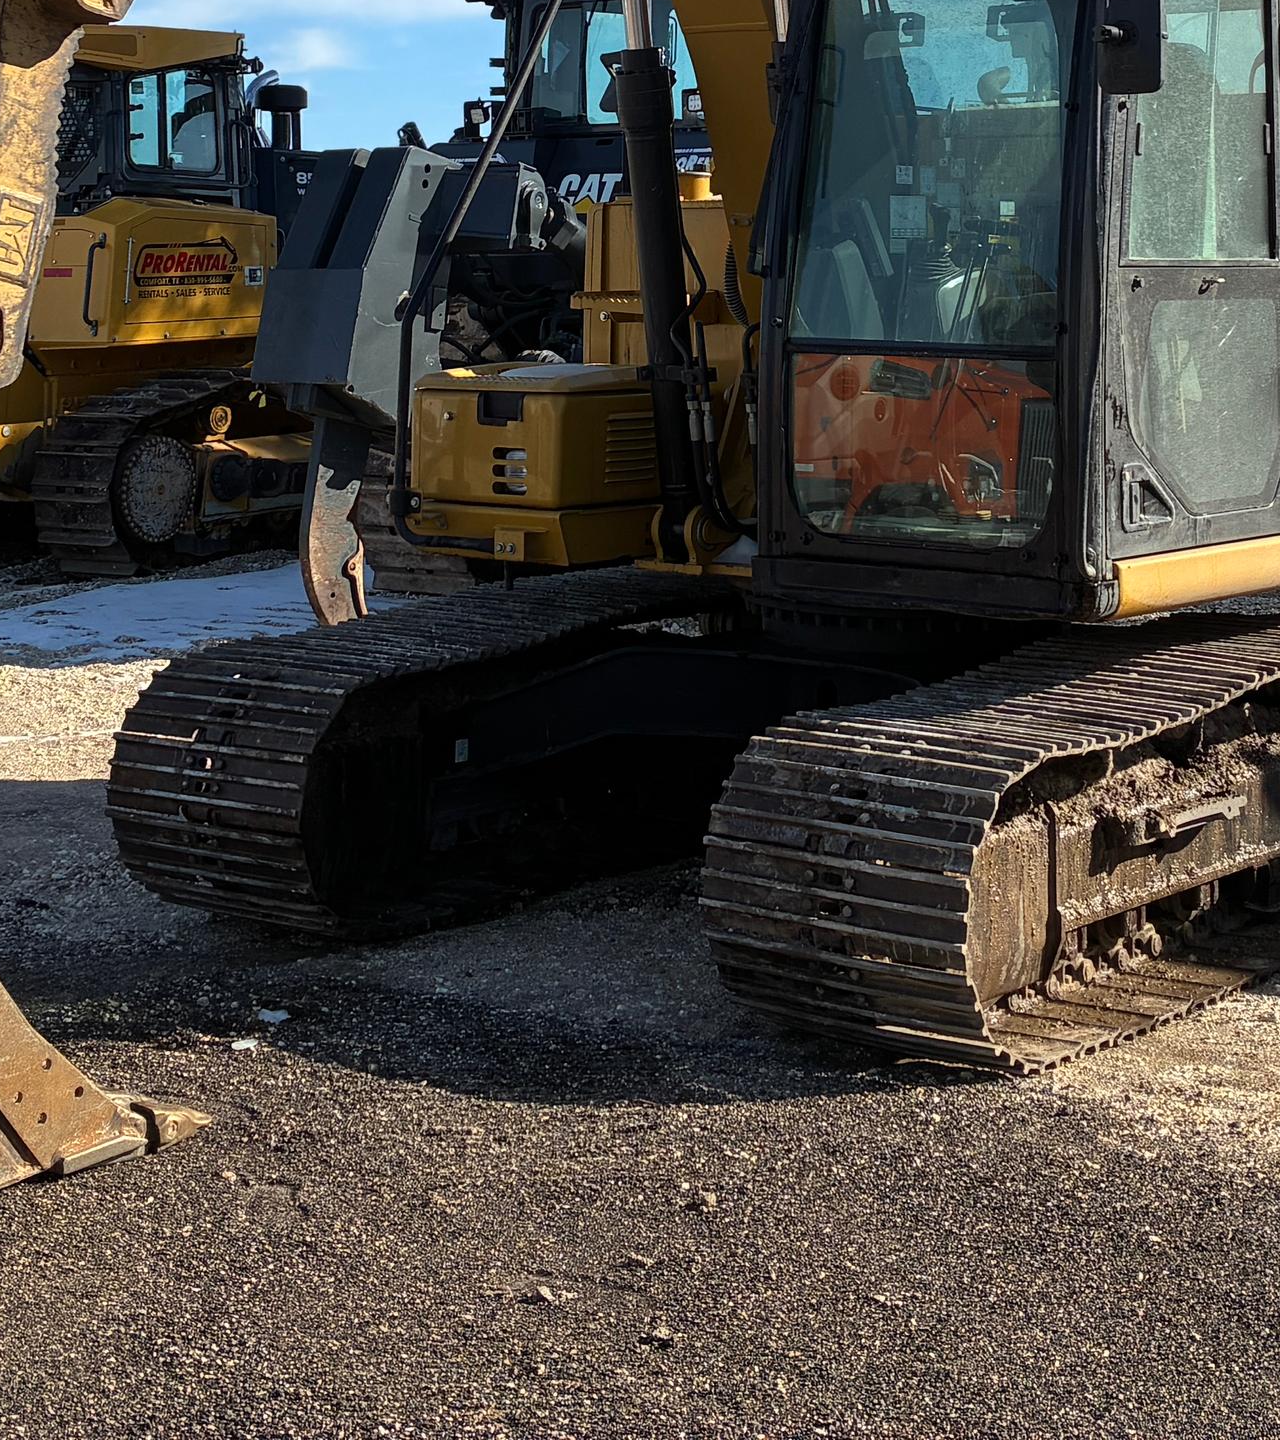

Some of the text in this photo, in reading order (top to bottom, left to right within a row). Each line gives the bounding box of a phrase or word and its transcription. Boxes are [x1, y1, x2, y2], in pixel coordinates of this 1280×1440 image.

[558, 173, 623, 204] CAT
[138, 287, 231, 299] RENTALS SALES SERVICE
